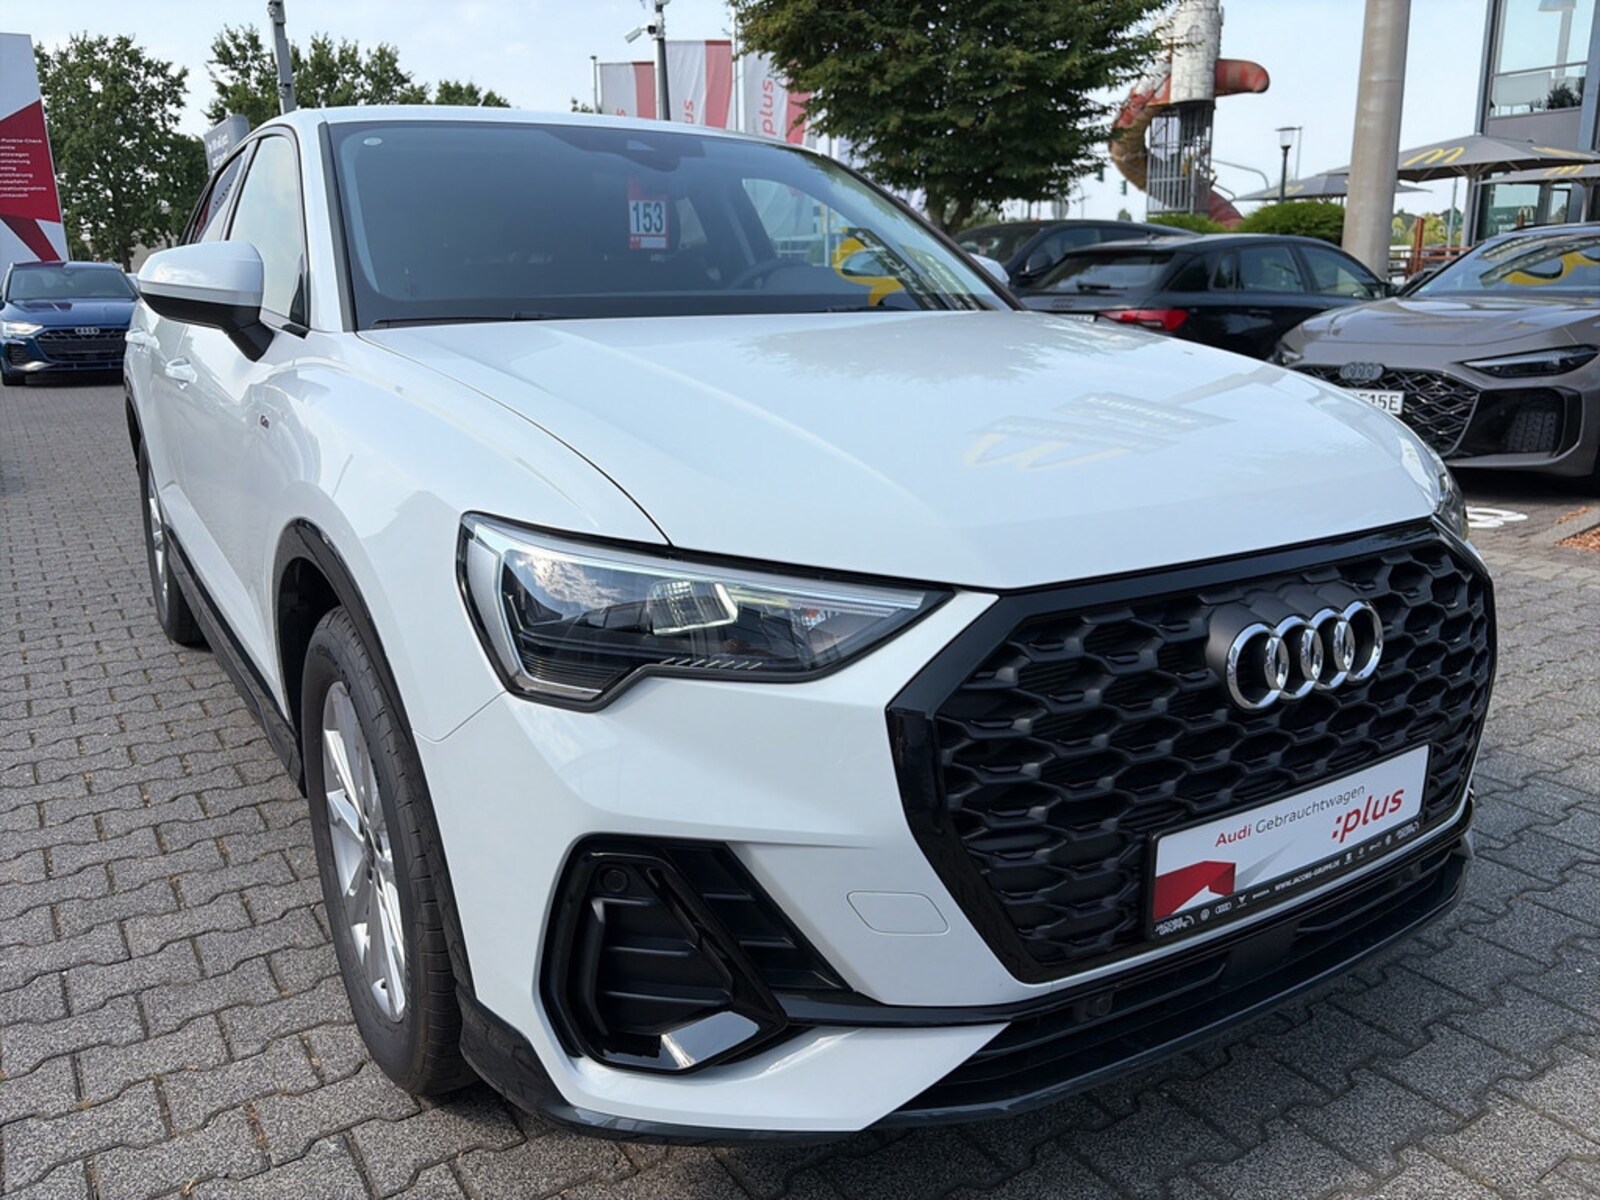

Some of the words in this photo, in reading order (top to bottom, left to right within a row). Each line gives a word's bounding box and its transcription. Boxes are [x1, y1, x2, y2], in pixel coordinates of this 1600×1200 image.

[758, 79, 777, 136] plus
[632, 202, 664, 233] 153
[1359, 392, 1399, 411] 15E
[1215, 825, 1252, 847] Audi
[1255, 784, 1365, 835] Gebrauchtwagen
